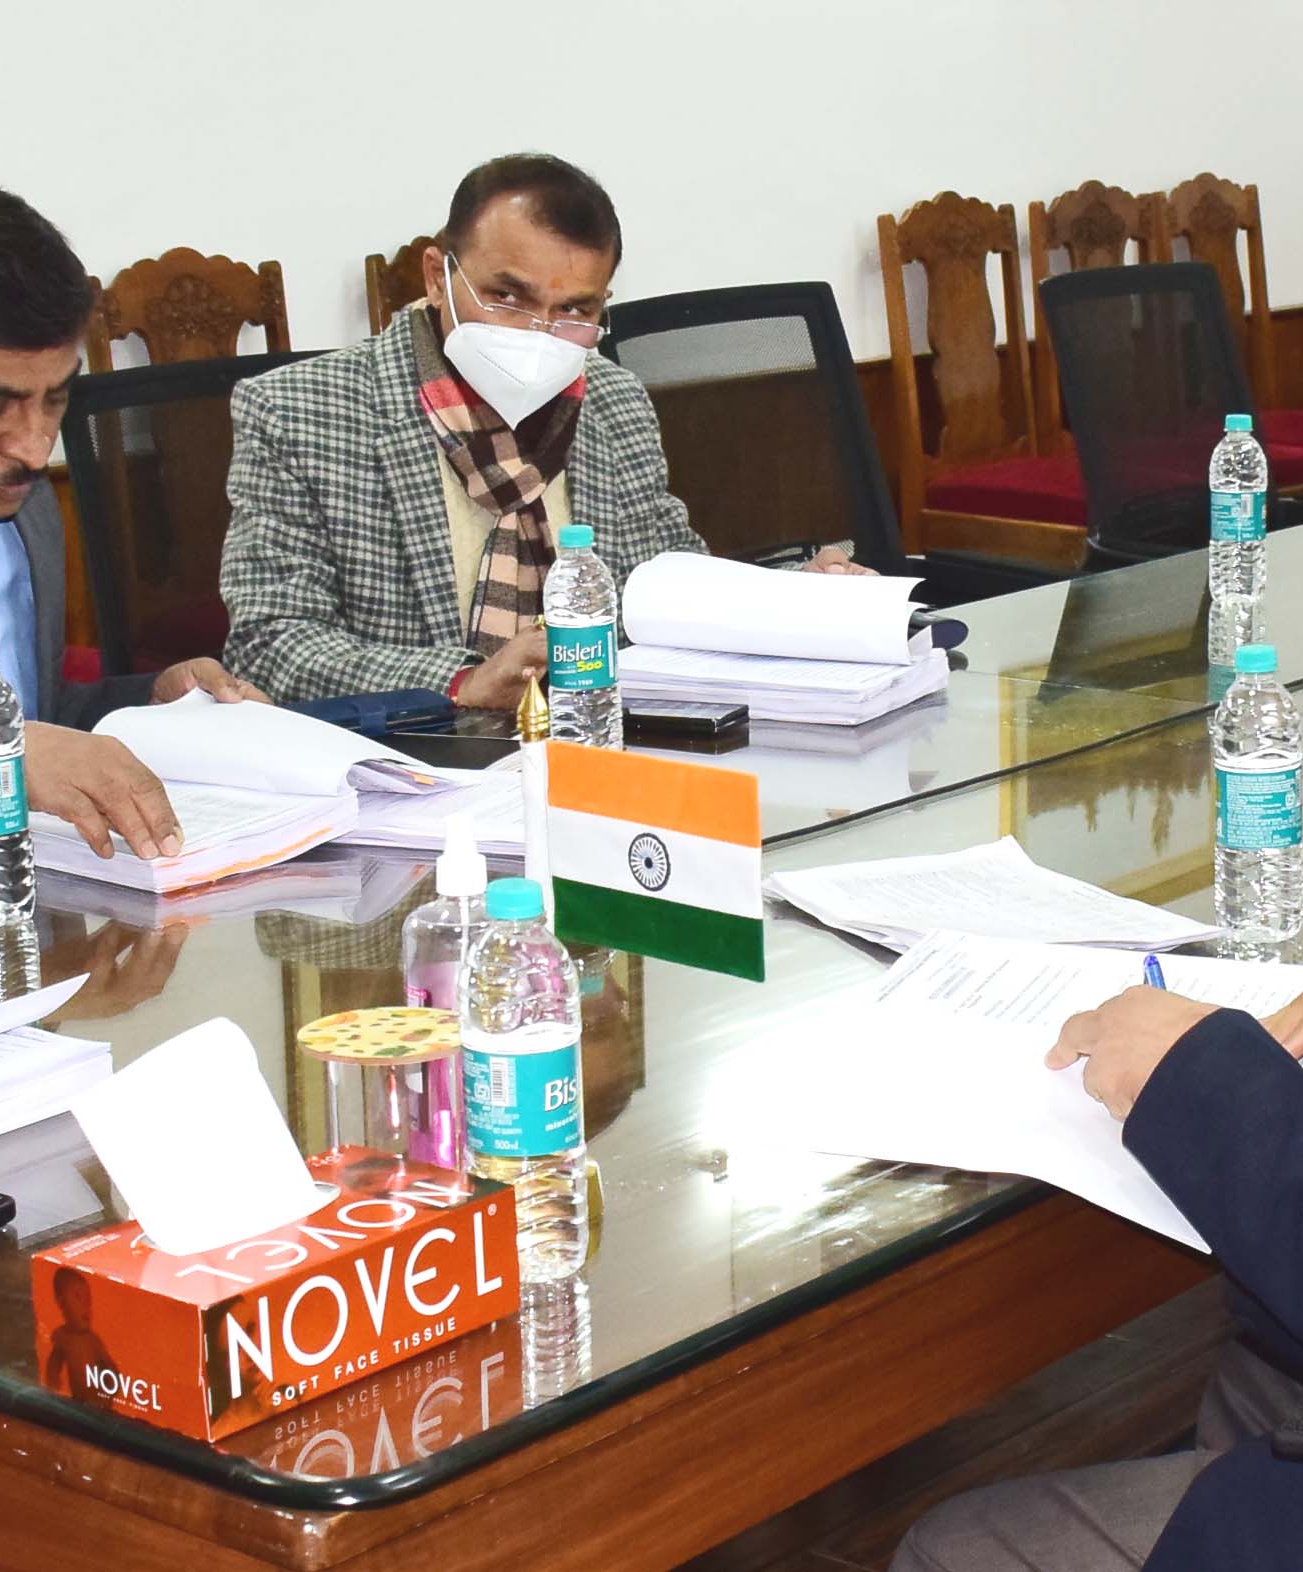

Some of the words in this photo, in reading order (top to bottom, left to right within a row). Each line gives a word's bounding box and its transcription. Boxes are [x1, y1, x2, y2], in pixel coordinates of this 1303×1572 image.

[553, 640, 602, 663] Bisleri
[174, 1181, 474, 1284] NOVEL
[226, 1211, 502, 1399] NOVEL
[85, 1363, 162, 1411] NOVEL
[272, 1375, 319, 1406] SOFT
[334, 1350, 379, 1380] FACE
[393, 1317, 457, 1354] TISSUE
